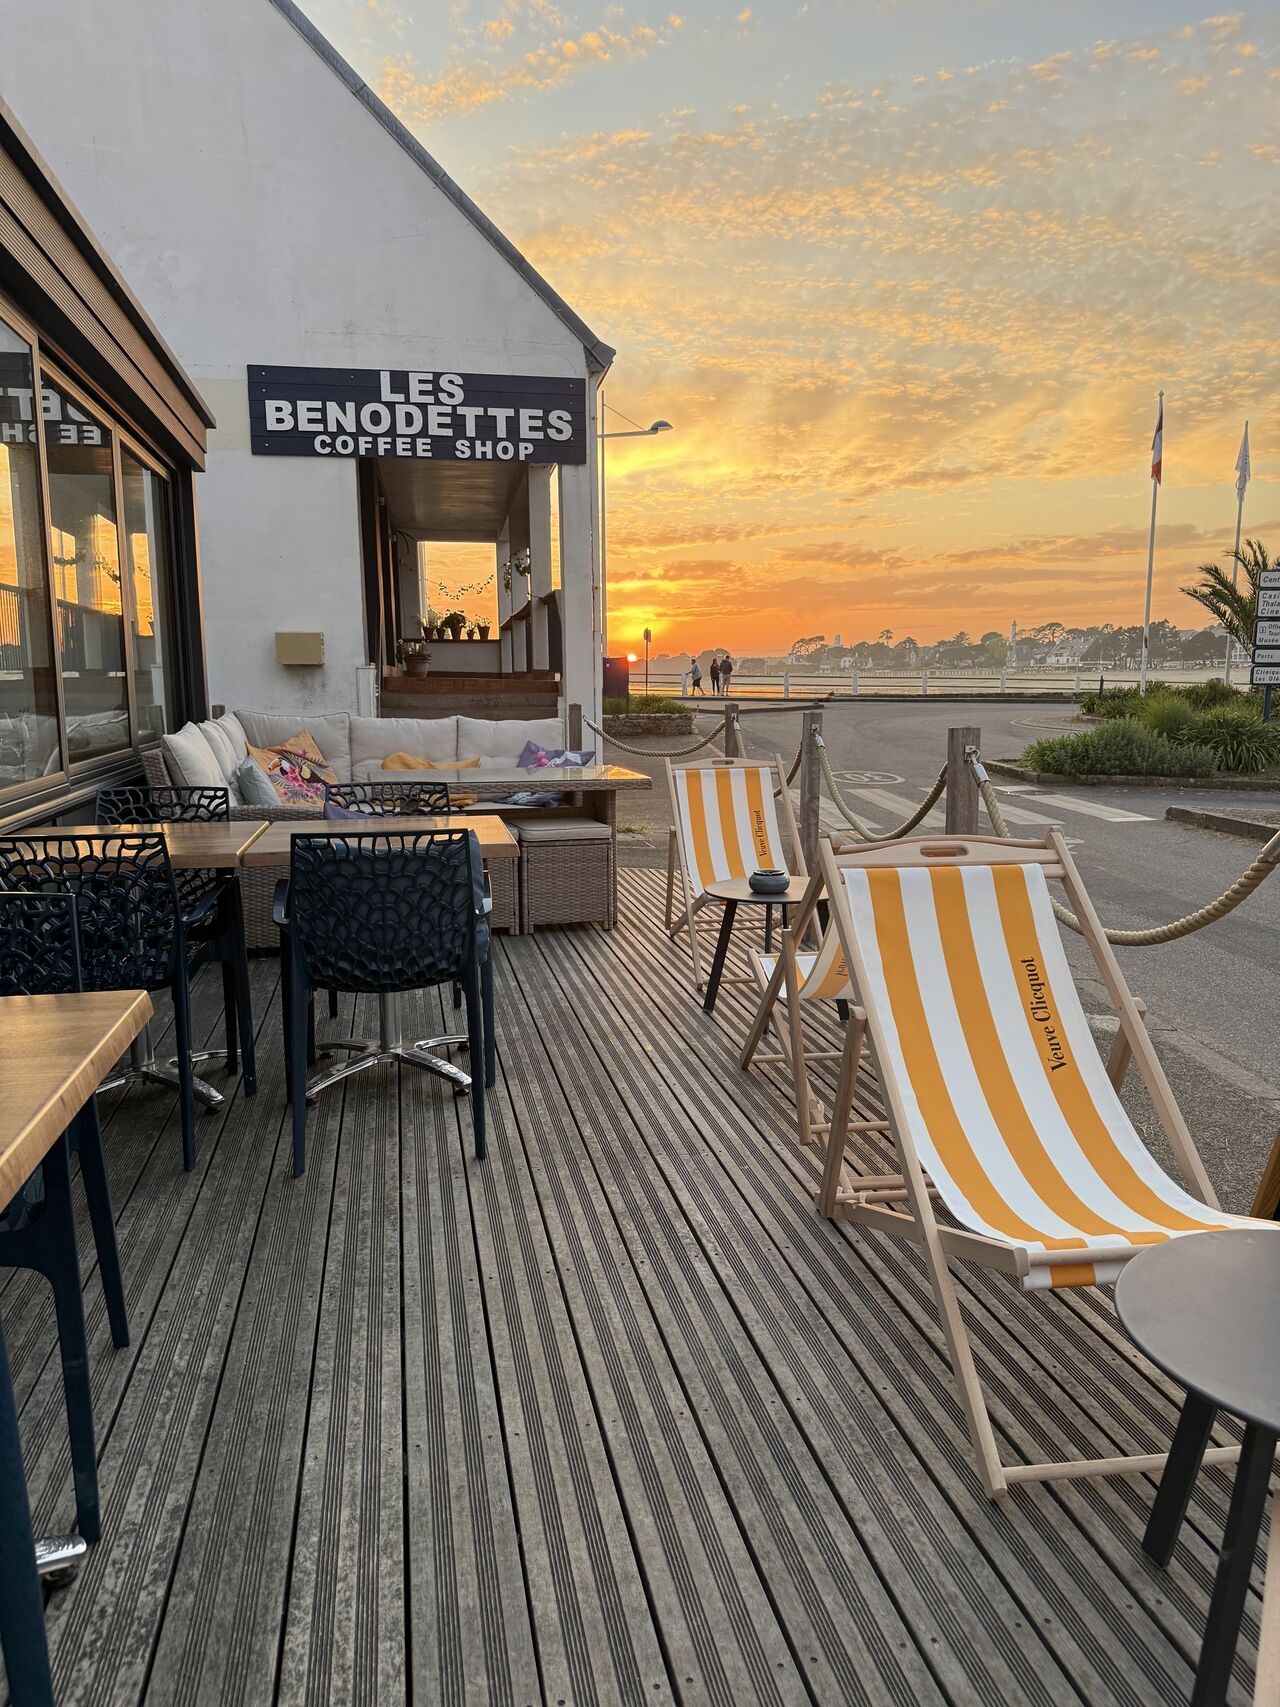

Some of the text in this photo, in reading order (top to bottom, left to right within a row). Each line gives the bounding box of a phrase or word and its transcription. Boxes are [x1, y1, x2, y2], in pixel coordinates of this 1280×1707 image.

[379, 370, 465, 406] LES
[264, 399, 574, 441] BENODETTES
[314, 435, 534, 461] COFFEE SHOP
[753, 810, 767, 857] Veuve Clicquot
[1020, 957, 1067, 1073] Veuve Clicquot
